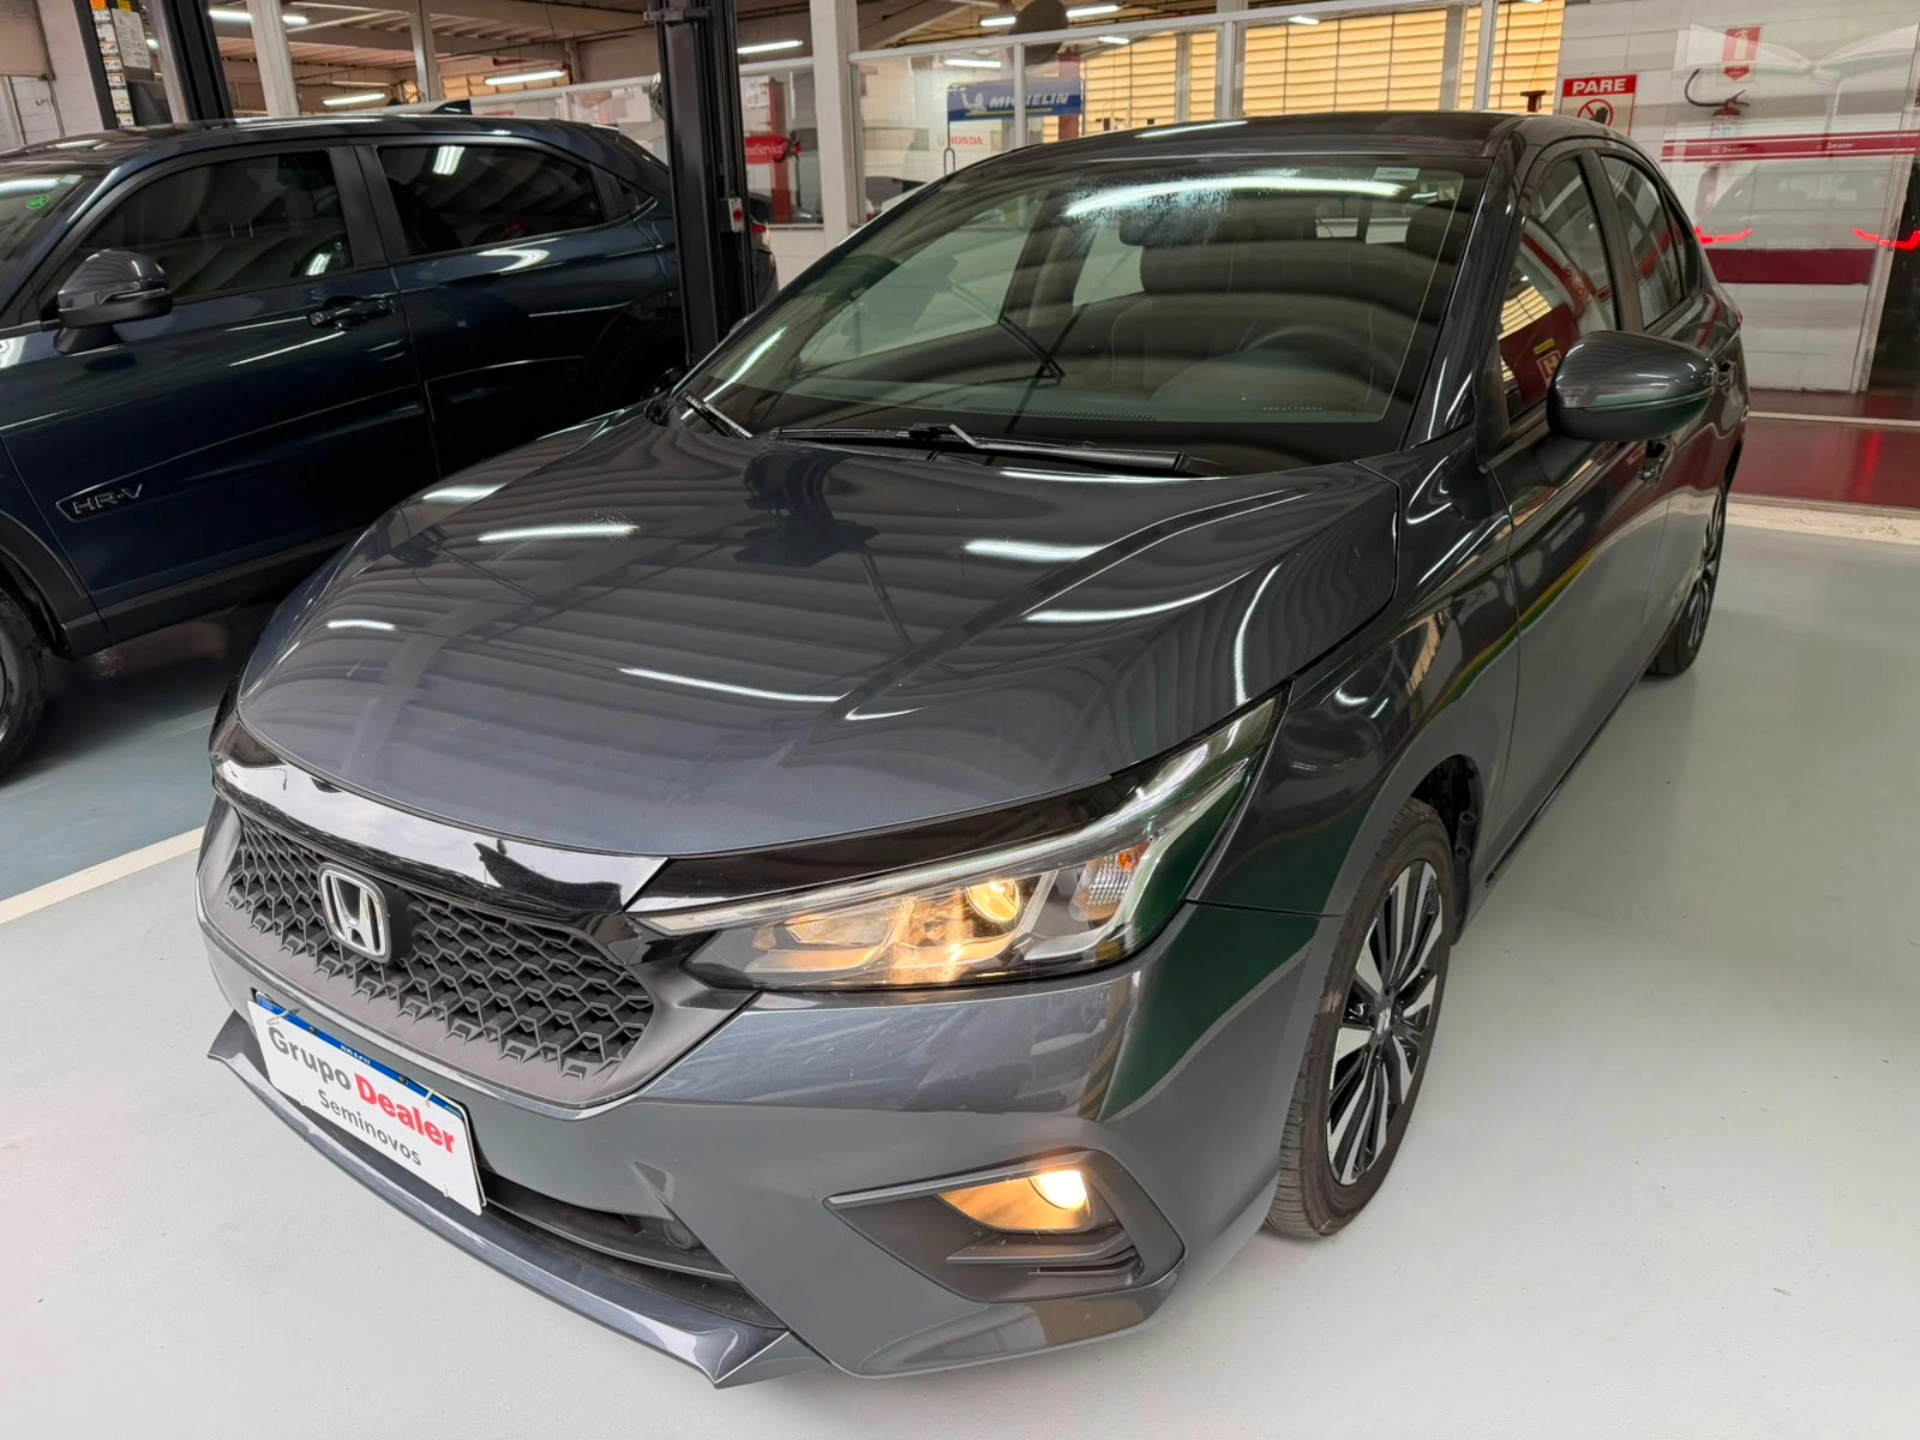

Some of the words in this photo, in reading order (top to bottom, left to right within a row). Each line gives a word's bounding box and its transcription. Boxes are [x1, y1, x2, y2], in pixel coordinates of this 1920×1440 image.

[989, 92, 1070, 109] MICELIN
[1572, 79, 1627, 95] PARE
[73, 483, 143, 515] HR-V
[268, 1026, 351, 1091] Grupo
[354, 1072, 456, 1154] Dealer
[317, 1088, 423, 1167] Seminovos
